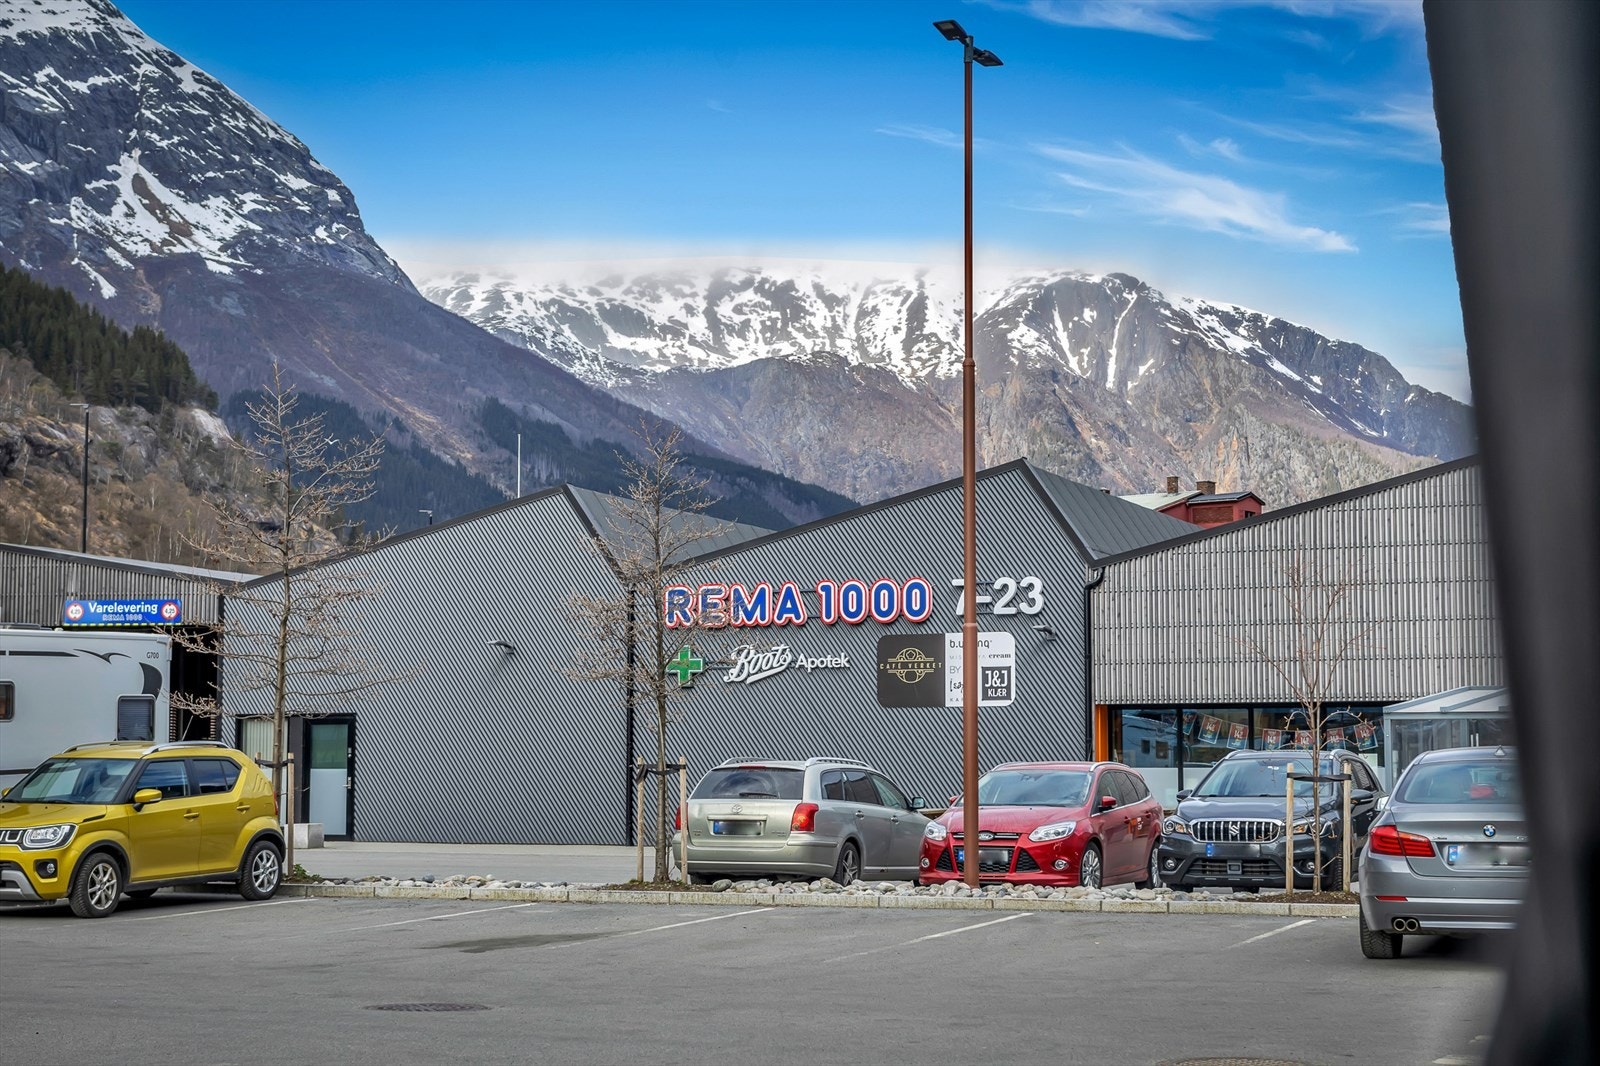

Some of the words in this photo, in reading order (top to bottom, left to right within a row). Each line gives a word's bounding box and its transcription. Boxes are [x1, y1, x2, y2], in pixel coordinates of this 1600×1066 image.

[88, 602, 158, 614] Varelevering
[663, 581, 808, 629] REMA
[815, 576, 933, 625] 1000
[102, 613, 125, 621] REMA
[126, 613, 143, 621] 1000
[146, 651, 160, 660] G700
[723, 643, 792, 684] Boots
[795, 652, 850, 673] Apotek
[984, 669, 1008, 688] J&J
[987, 688, 1007, 697] KLÆR
